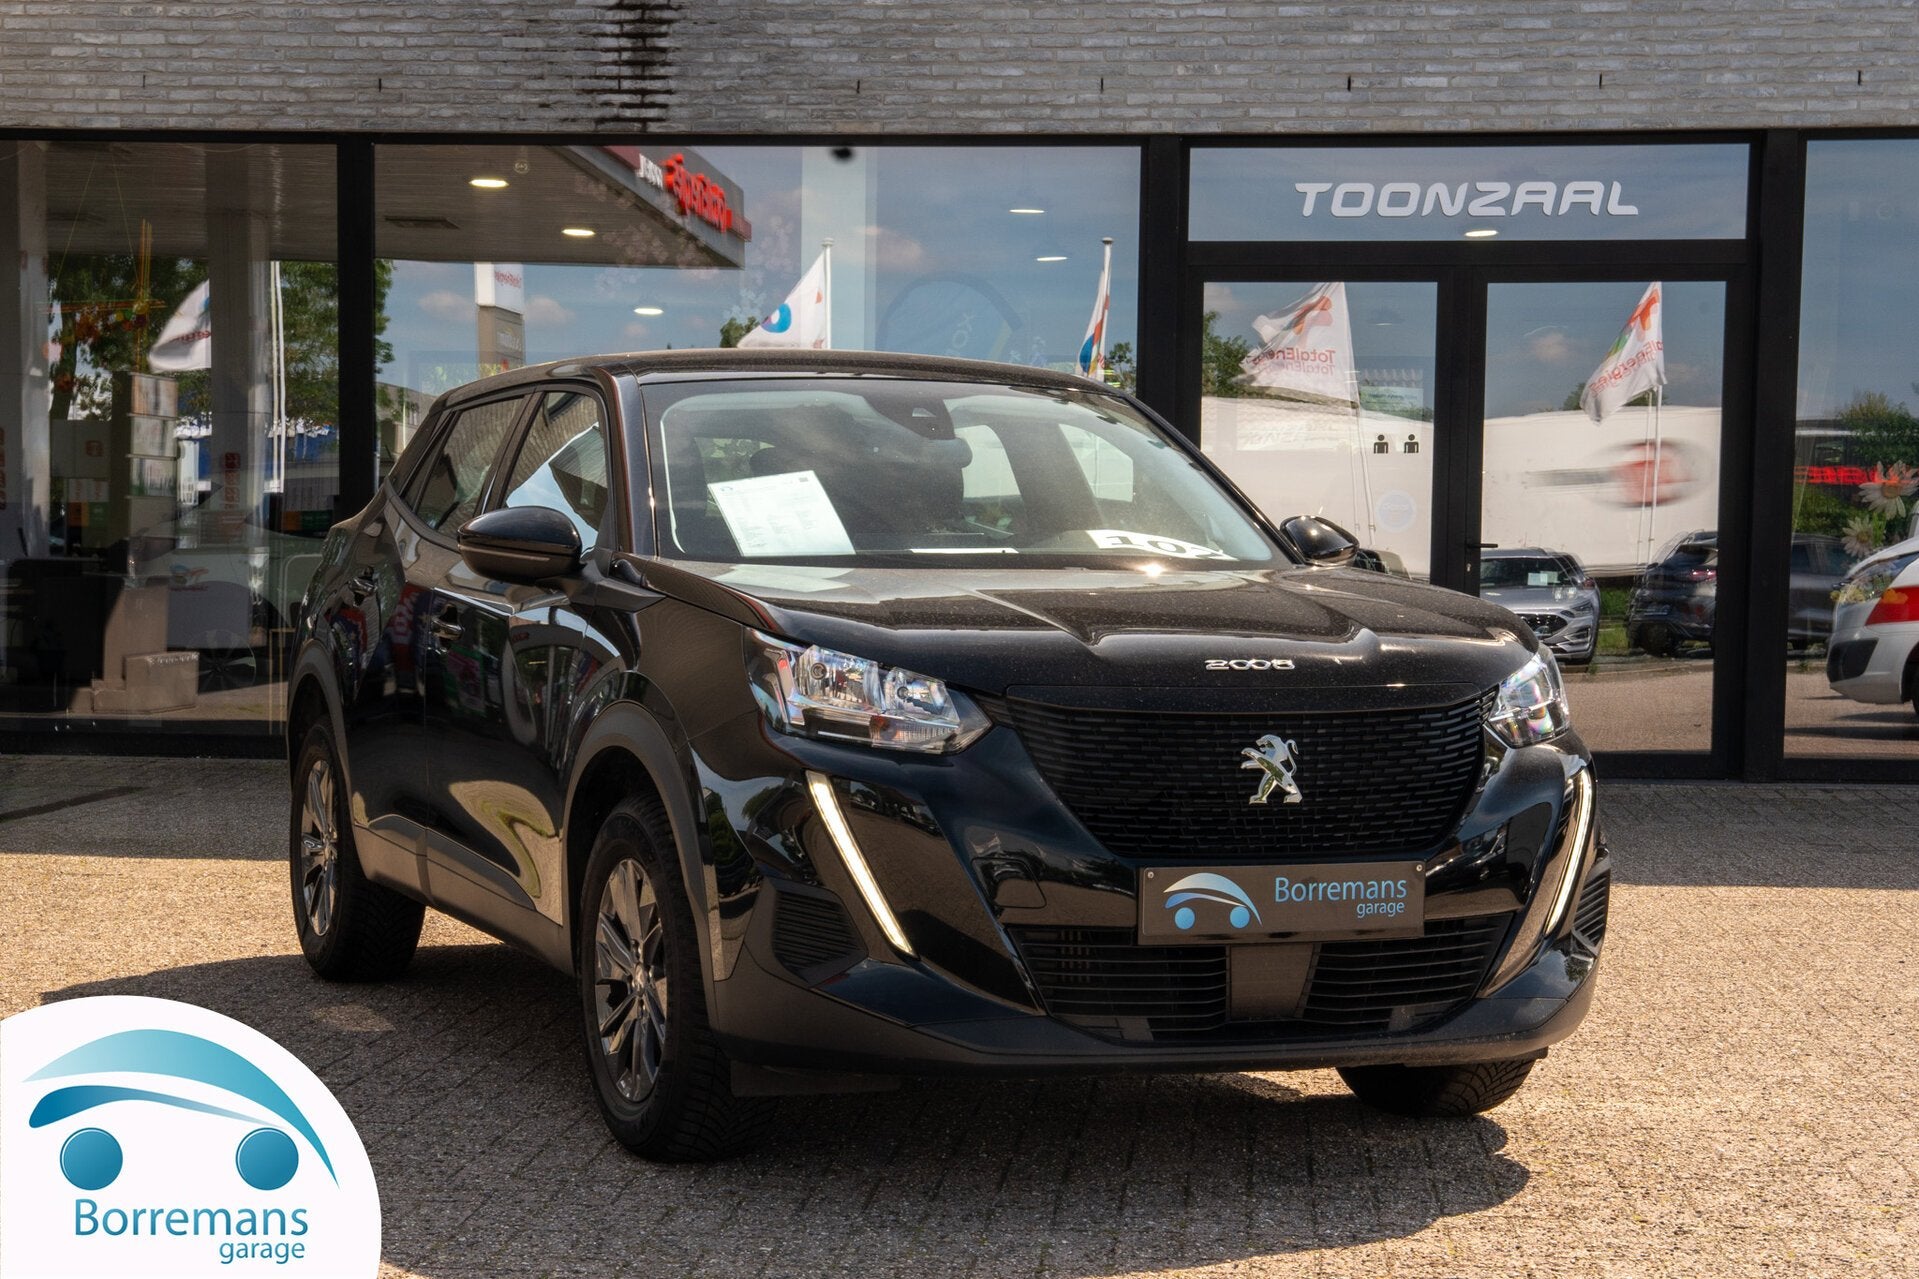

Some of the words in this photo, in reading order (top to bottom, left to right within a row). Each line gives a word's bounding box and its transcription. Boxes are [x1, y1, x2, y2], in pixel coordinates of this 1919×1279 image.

[1295, 181, 1639, 217] TOONZAAL
[1204, 658, 1296, 671] 2008
[1274, 876, 1408, 903] Borremans
[1356, 901, 1406, 919] garage
